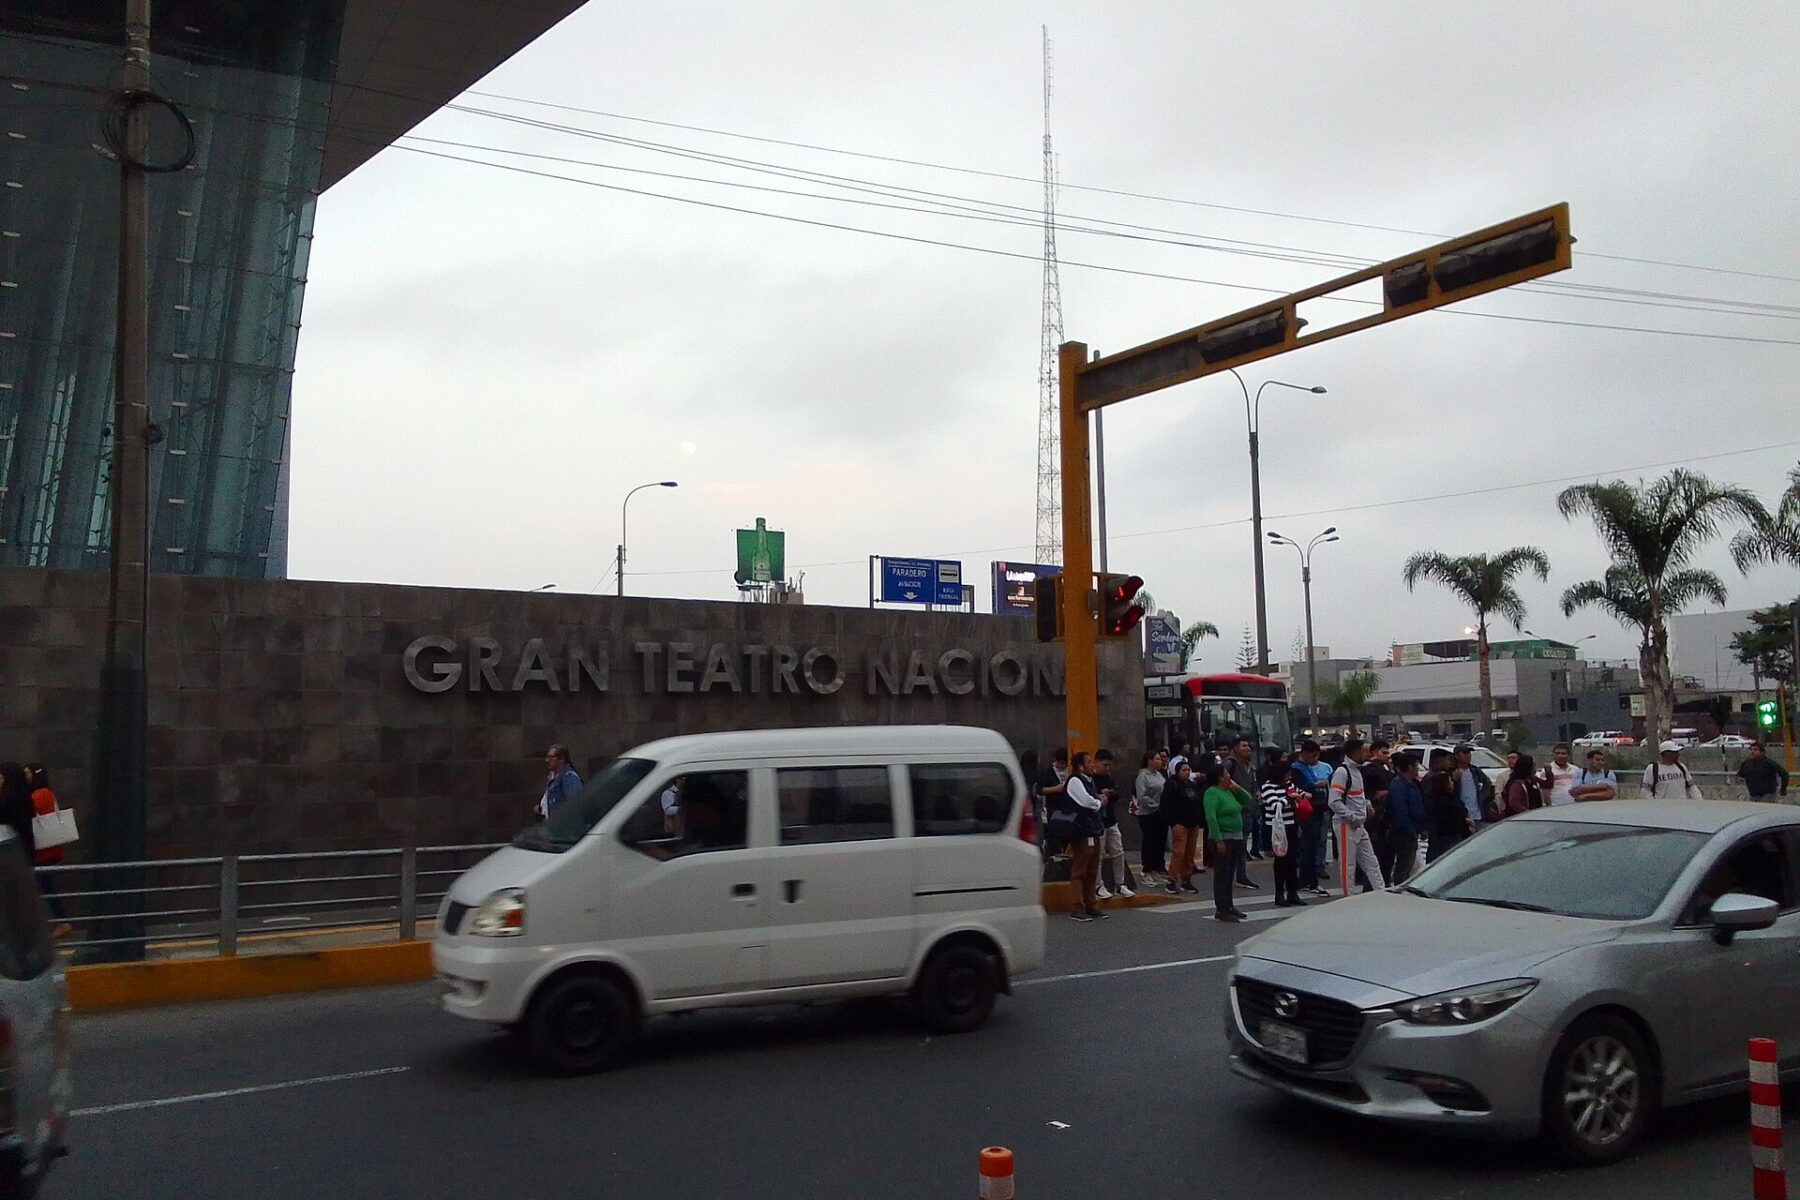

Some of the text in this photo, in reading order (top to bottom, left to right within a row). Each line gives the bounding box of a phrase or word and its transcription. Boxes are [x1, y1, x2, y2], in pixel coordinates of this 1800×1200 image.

[892, 567, 927, 578] PARADERO
[402, 635, 1113, 697] GRAN TEATRO NACIONL
